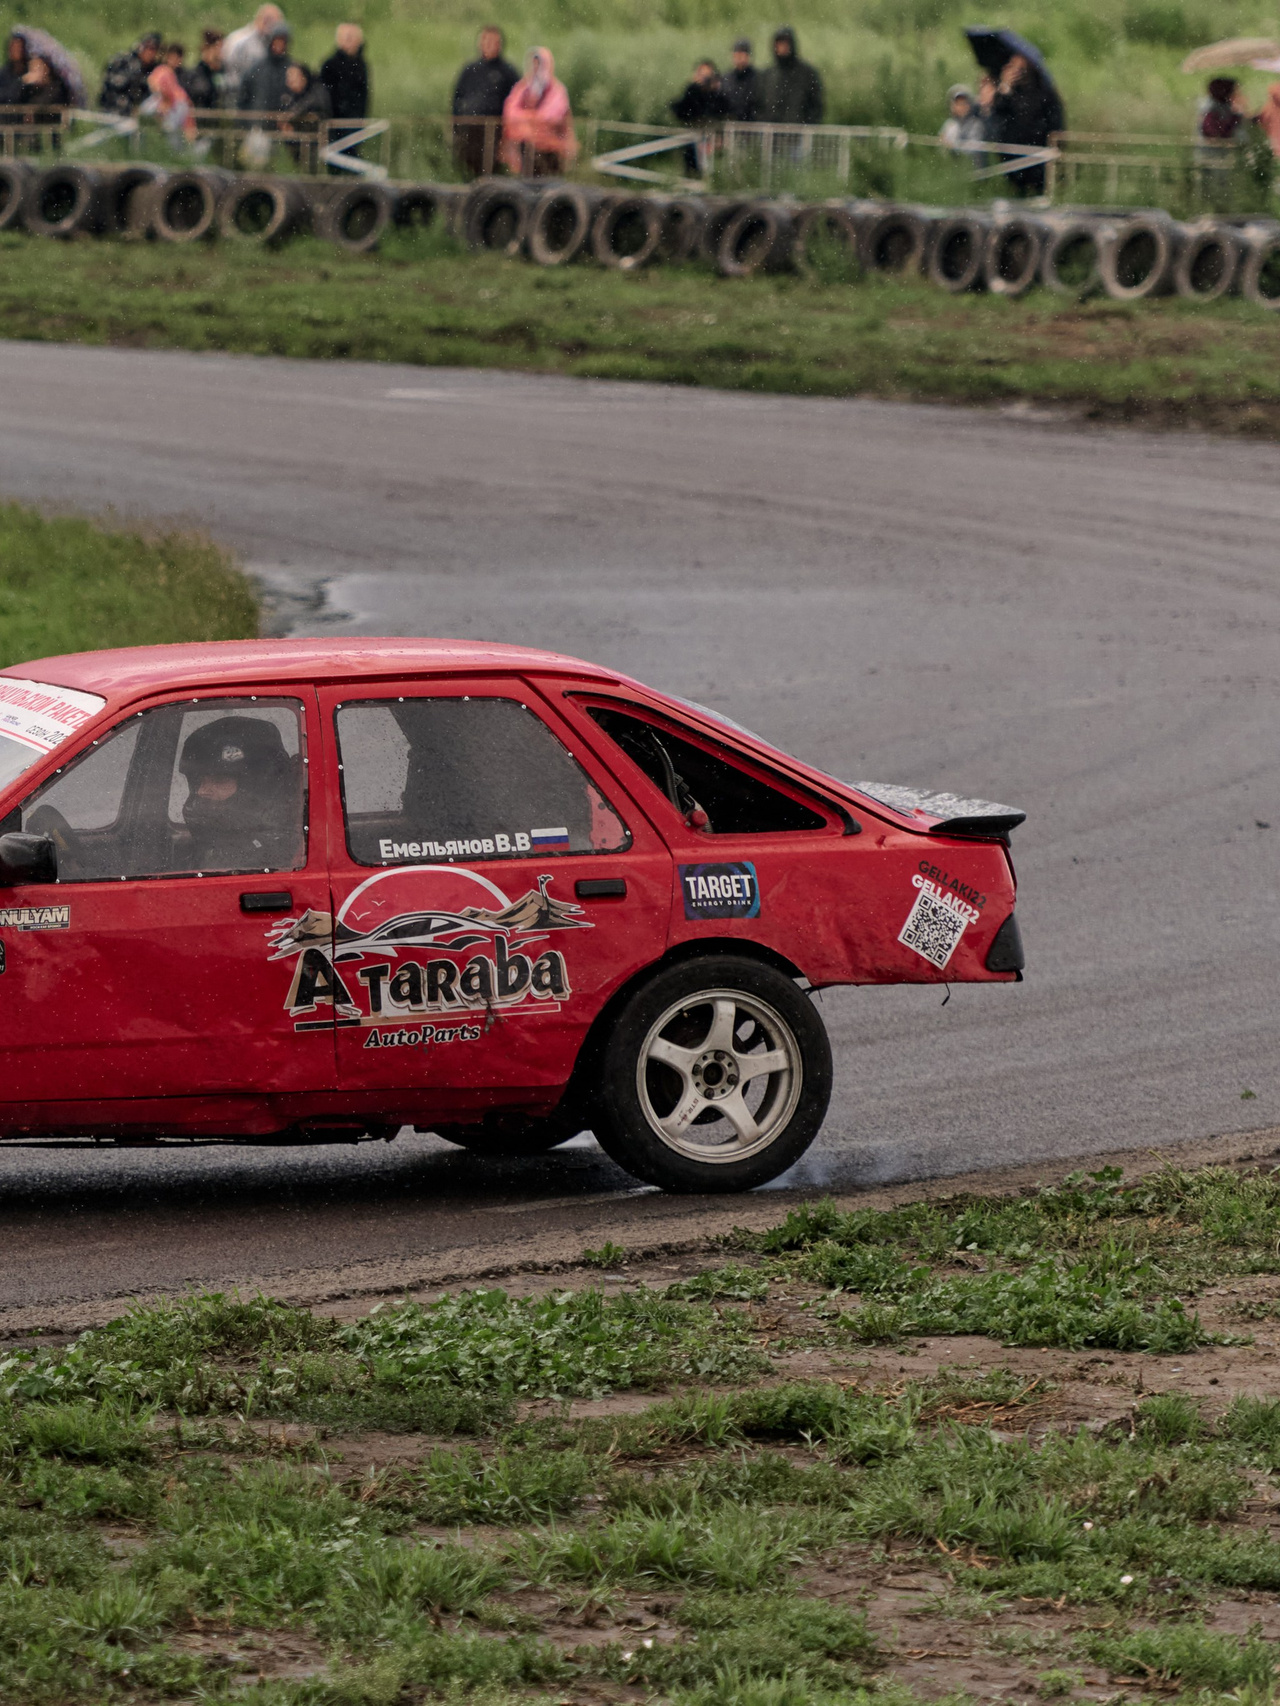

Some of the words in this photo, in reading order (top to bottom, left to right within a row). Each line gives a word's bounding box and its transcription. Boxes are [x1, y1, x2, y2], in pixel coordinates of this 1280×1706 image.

[379, 839, 495, 858] Емельянов
[685, 874, 752, 899] TARGET
[918, 860, 987, 909] GELLAKI22
[691, 900, 723, 908] ENERGY
[911, 874, 980, 925] GELLAKI22
